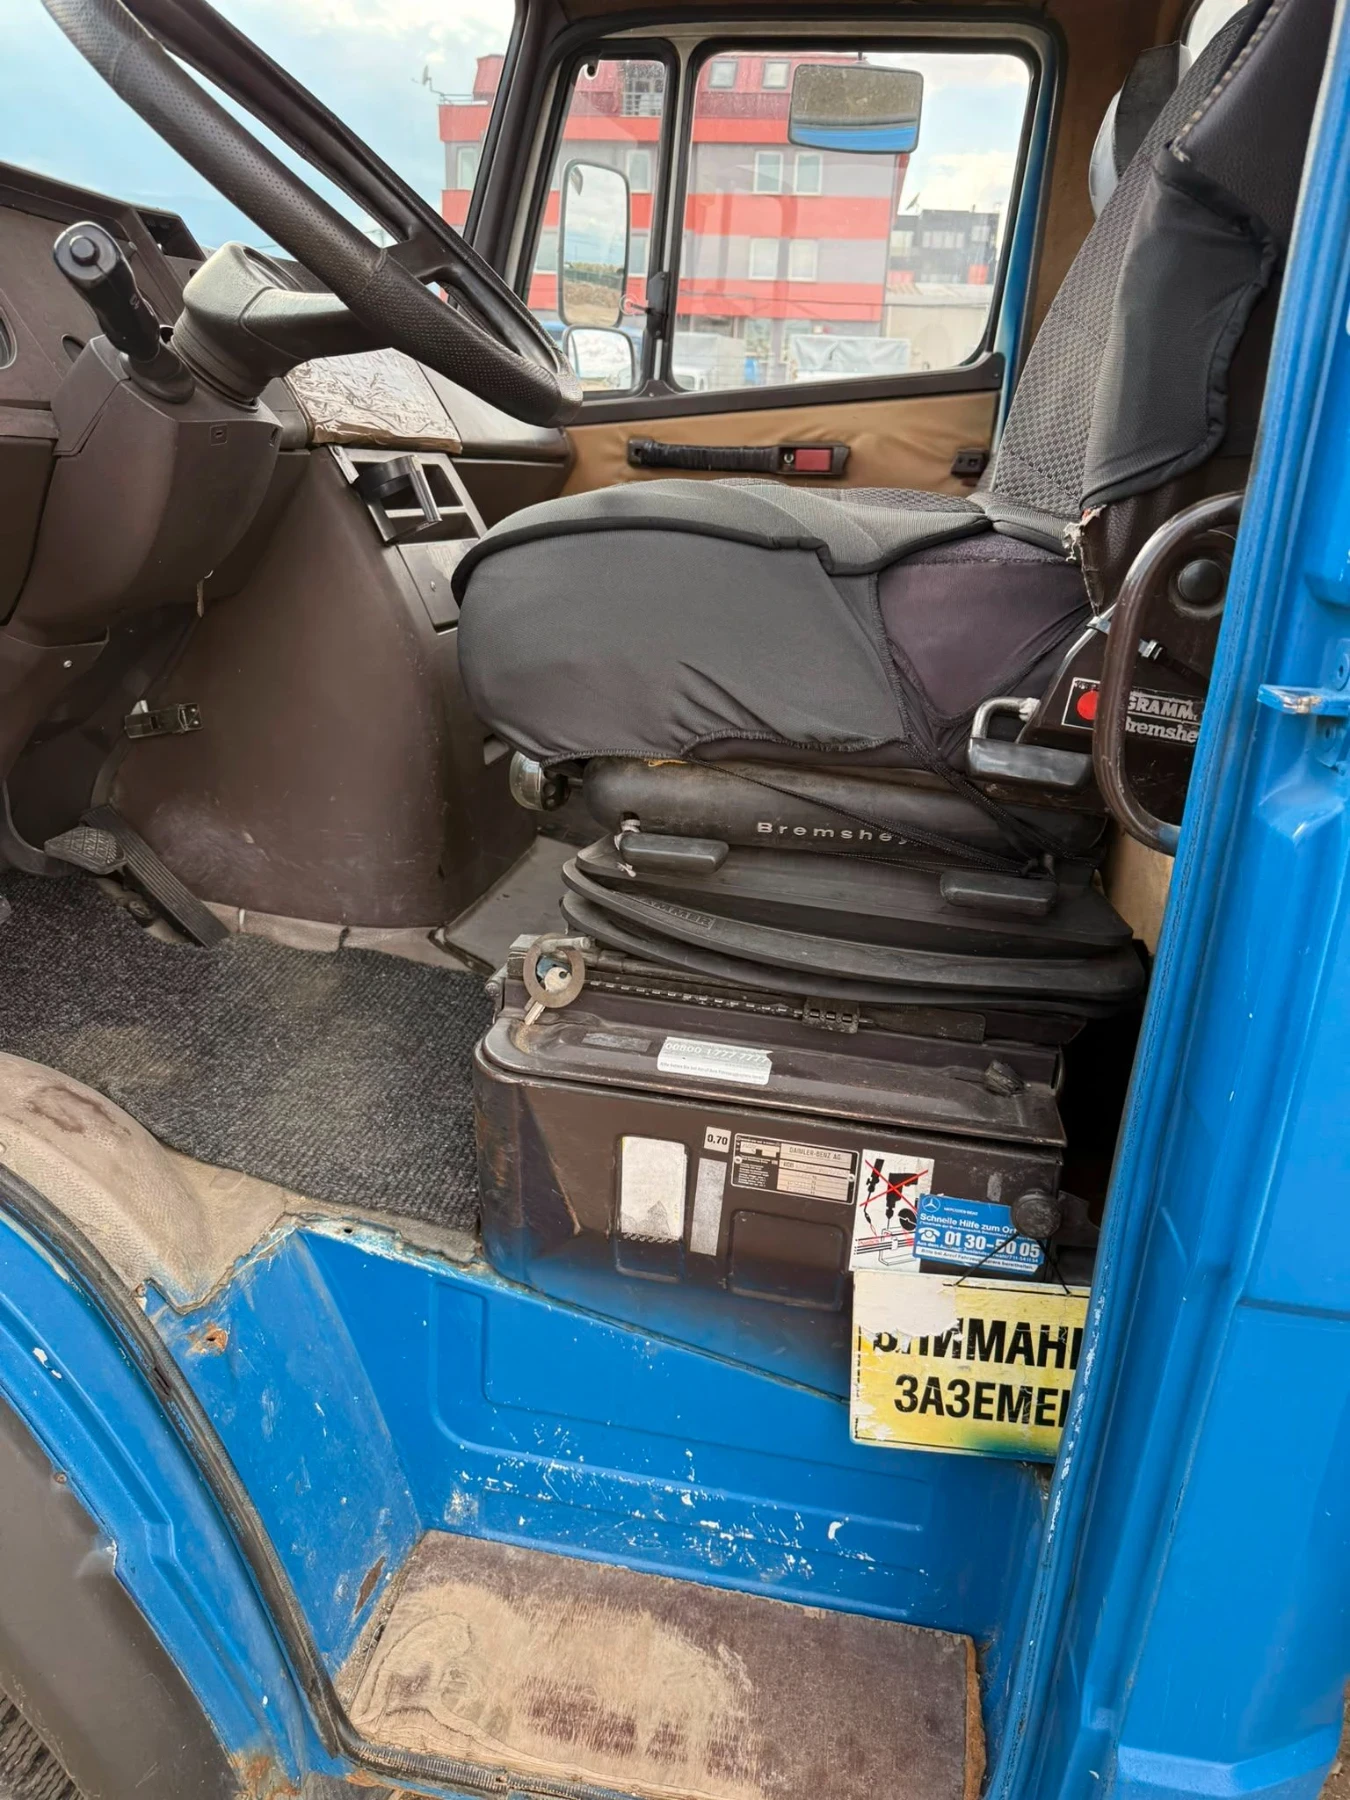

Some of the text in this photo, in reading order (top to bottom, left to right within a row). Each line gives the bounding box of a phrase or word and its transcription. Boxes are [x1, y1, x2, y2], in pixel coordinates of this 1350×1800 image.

[1127, 696, 1199, 722] GRAMM
[665, 1042, 702, 1054] 00800
[706, 1047, 737, 1059] 1777
[707, 1134, 728, 1146] 0.70
[920, 1212, 958, 1226] Schnelle
[959, 1219, 980, 1230] Hilfe
[981, 1223, 1000, 1232] zum
[1002, 1226, 1017, 1235] Ort
[944, 1230, 962, 1246] 01
[1019, 1242, 1041, 1259] 05
